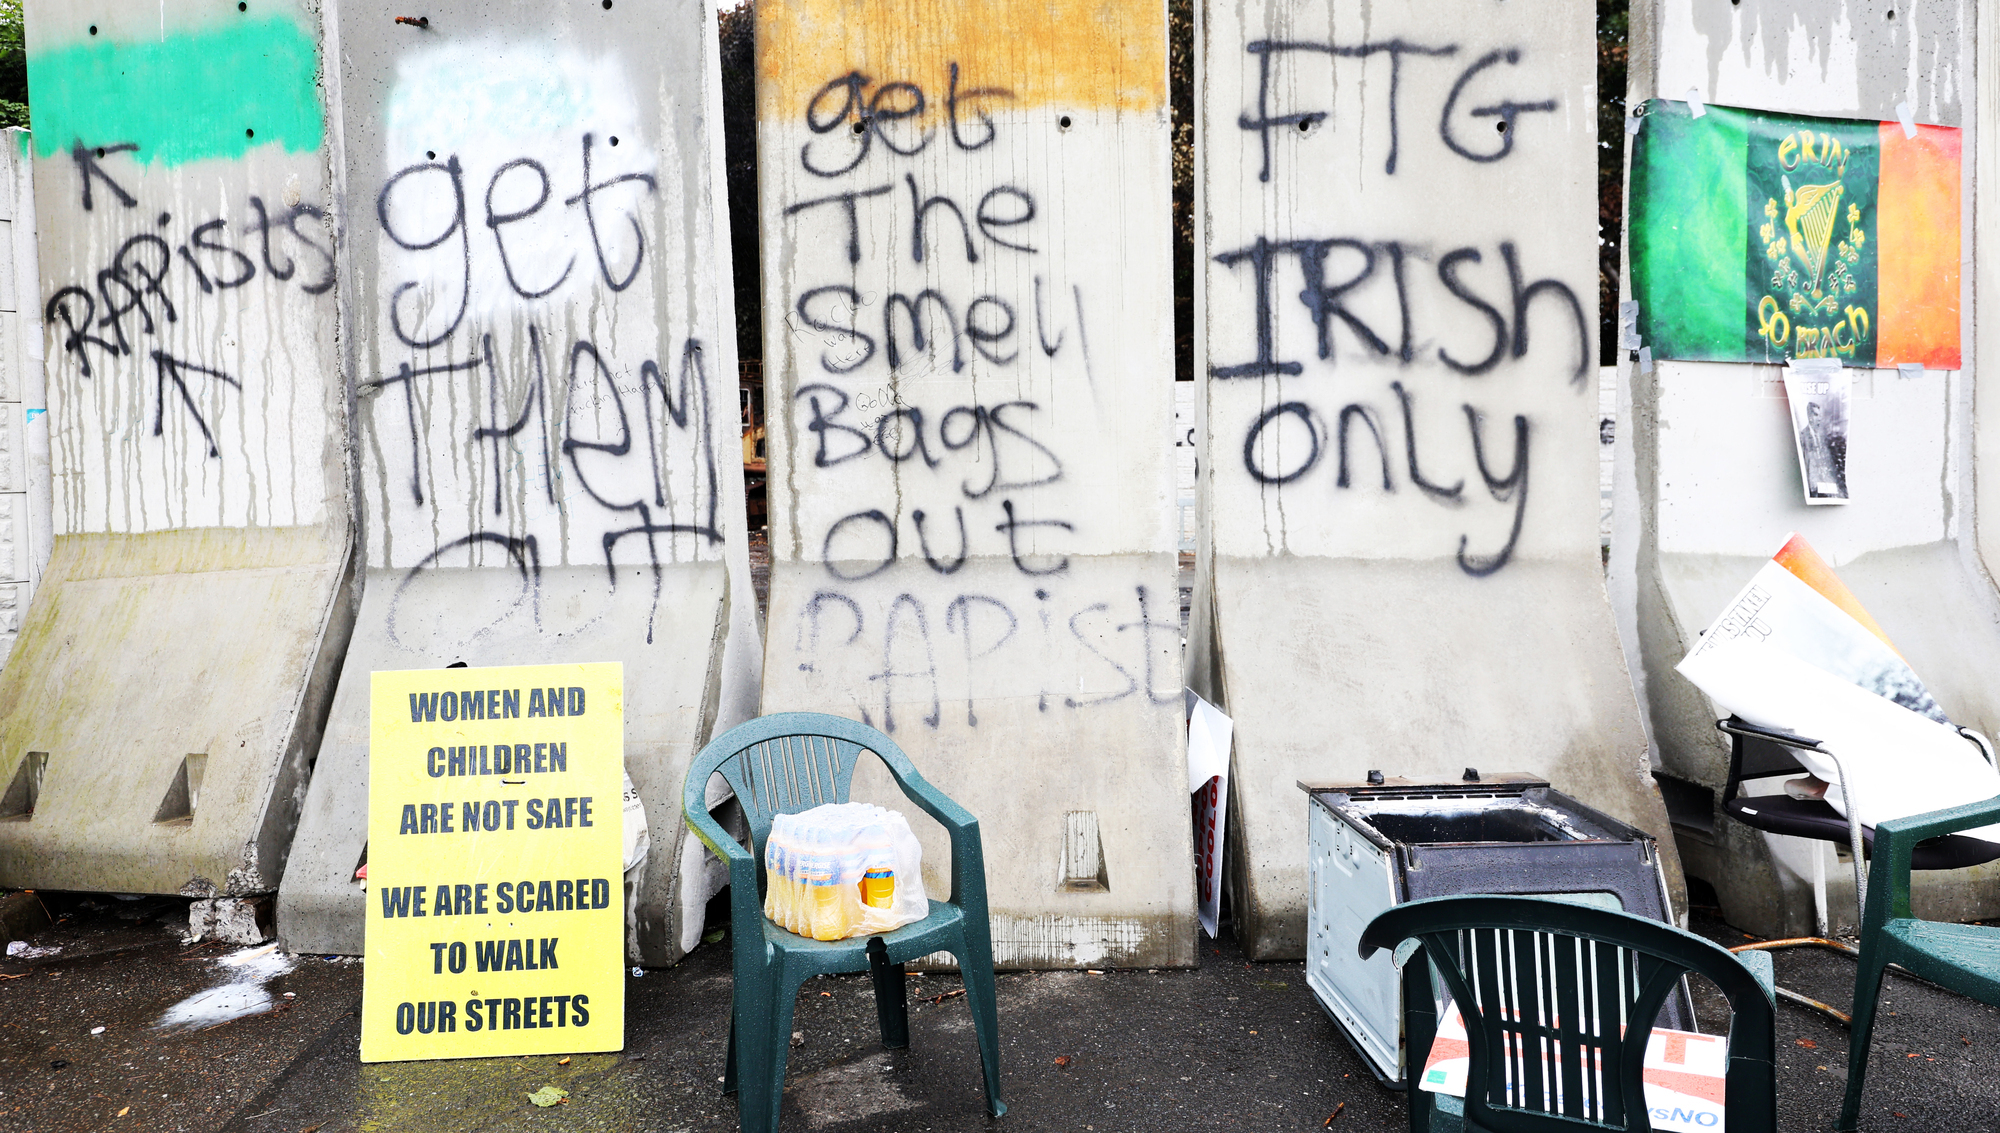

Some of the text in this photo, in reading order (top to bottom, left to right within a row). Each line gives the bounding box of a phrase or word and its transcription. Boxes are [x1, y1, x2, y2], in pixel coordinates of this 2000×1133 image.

[801, 61, 1016, 178] get
[1237, 39, 1558, 182] FTG
[377, 133, 657, 349] get
[784, 171, 1038, 263] The
[795, 382, 1063, 500] Bags
[822, 500, 1076, 582] out
[409, 686, 586, 723] WOMEN AND
[427, 742, 567, 778] CHILDREN
[399, 796, 593, 835] ARE NOT SAFE
[381, 879, 610, 919] WE ARE SCARED
[429, 938, 559, 975] TO WALK
[396, 994, 590, 1036] OUR STREETS
